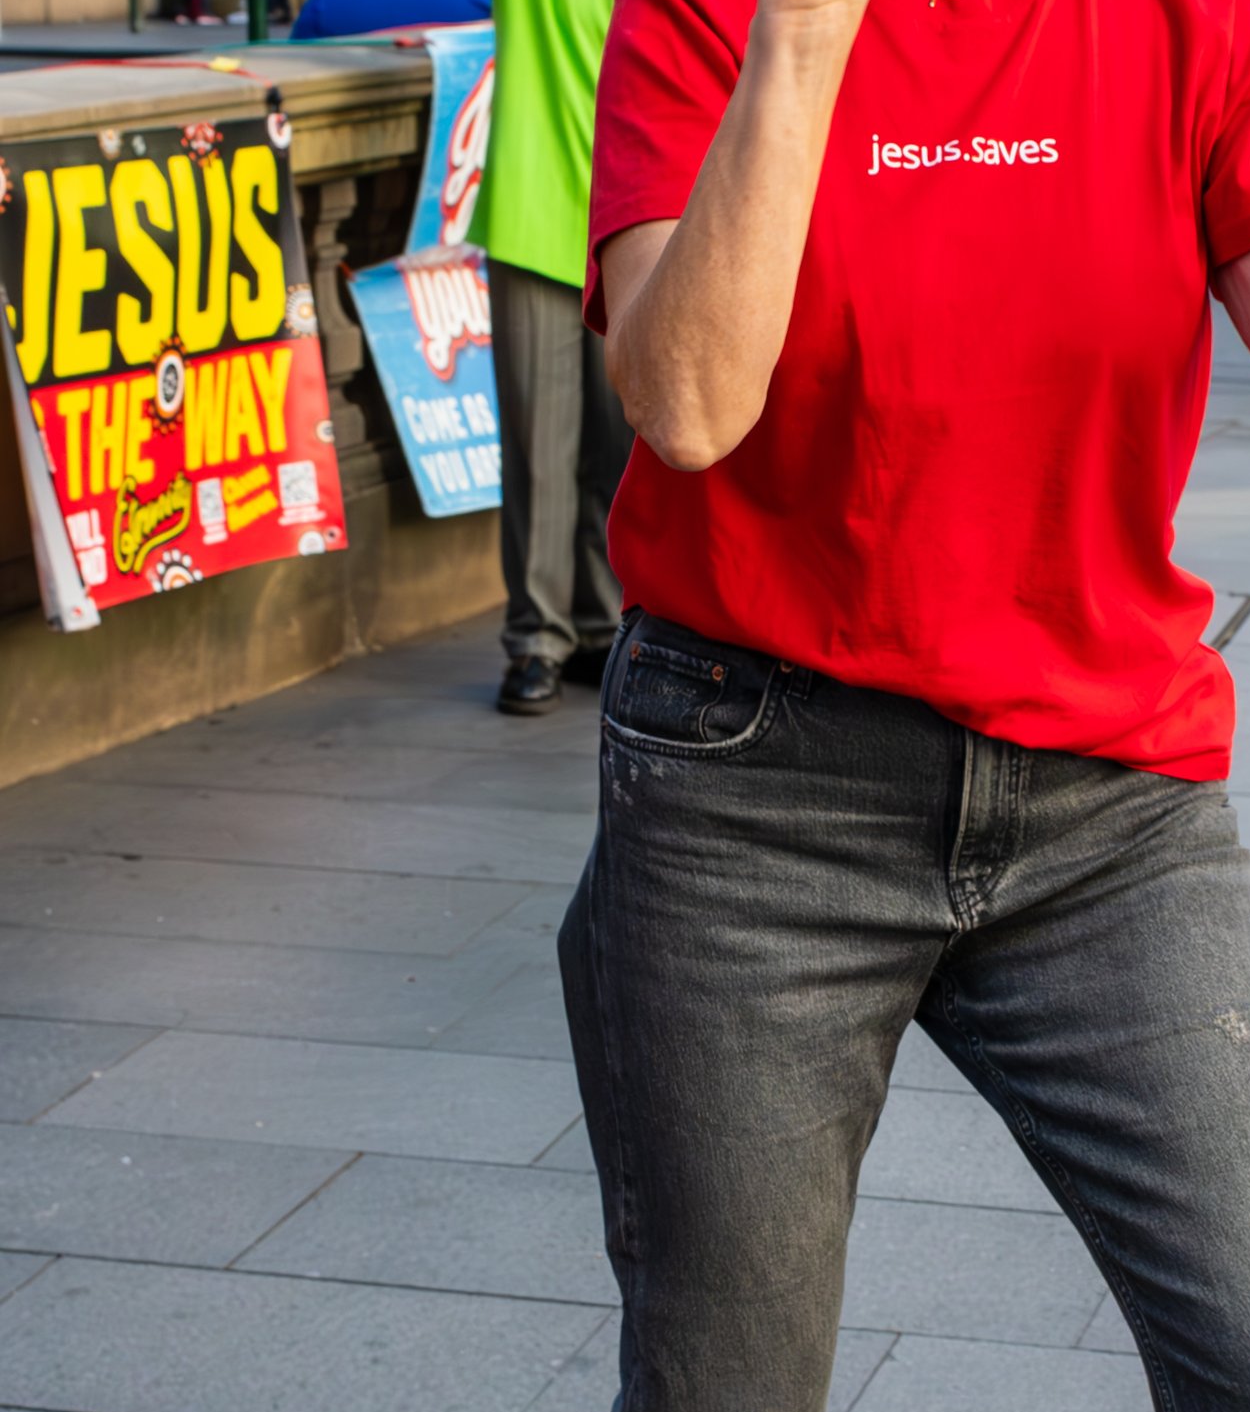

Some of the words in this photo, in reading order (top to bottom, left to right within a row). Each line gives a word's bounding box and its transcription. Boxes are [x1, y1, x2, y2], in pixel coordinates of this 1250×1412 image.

[5, 144, 287, 385] JESUS
[56, 374, 157, 501] THE
[183, 347, 293, 471] WAY
[402, 395, 468, 444] COME
[419, 449, 470, 495] YOU
